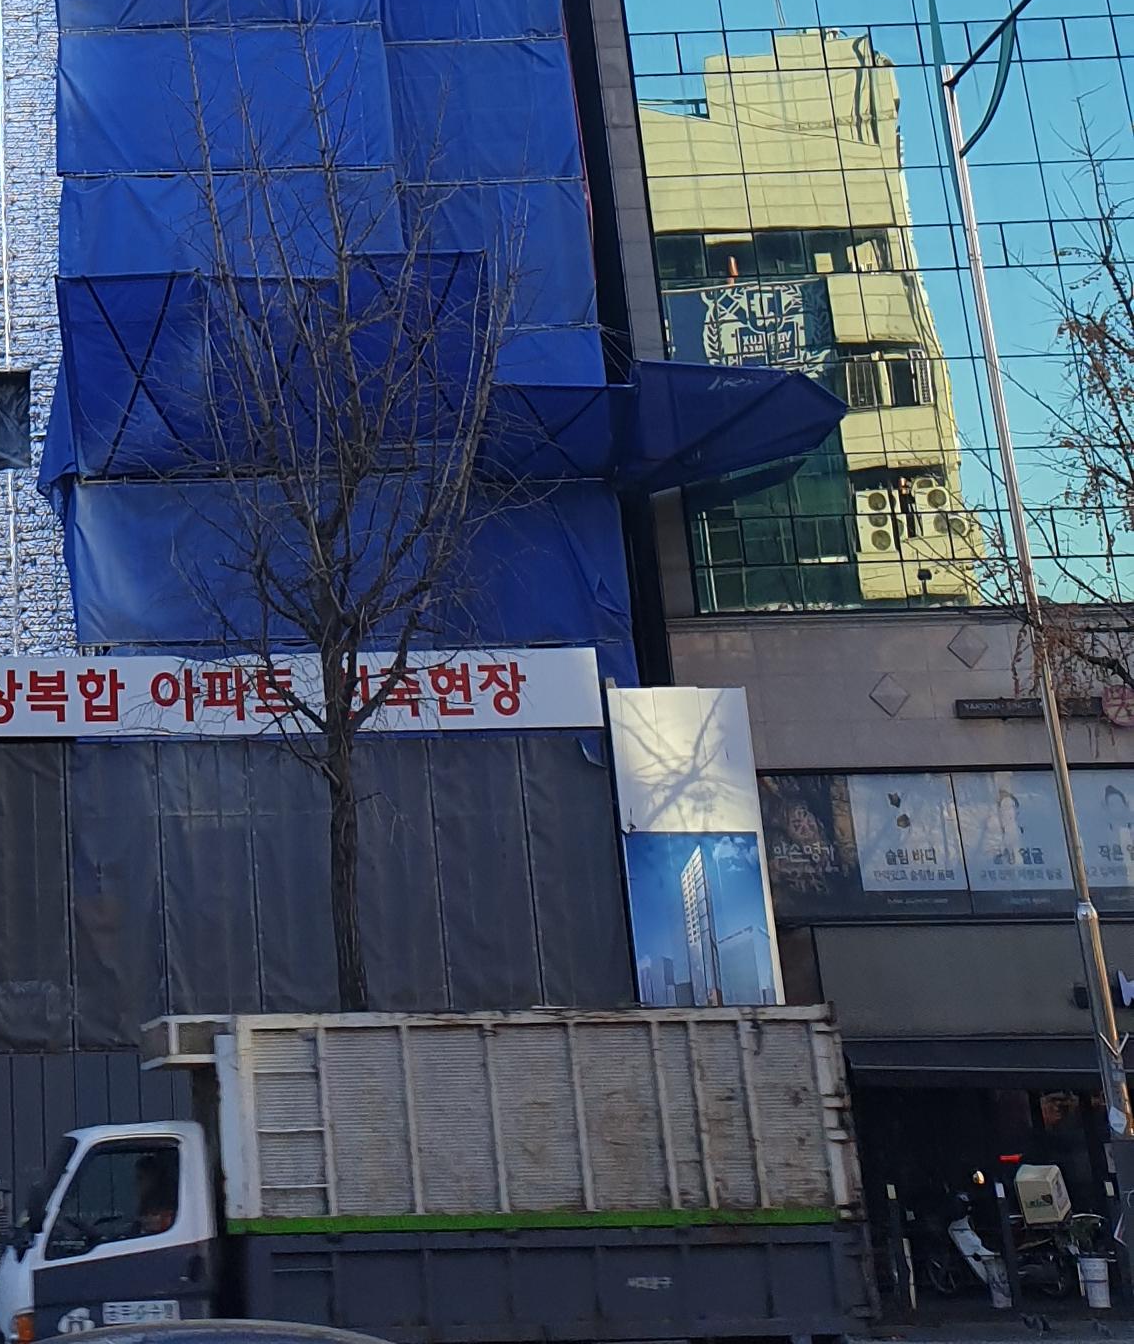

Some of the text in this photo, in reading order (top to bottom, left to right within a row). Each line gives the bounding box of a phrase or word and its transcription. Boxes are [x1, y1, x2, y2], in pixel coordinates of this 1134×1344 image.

[150, 666, 298, 722] 아파트
[885, 847, 937, 865] 슬림 바디
